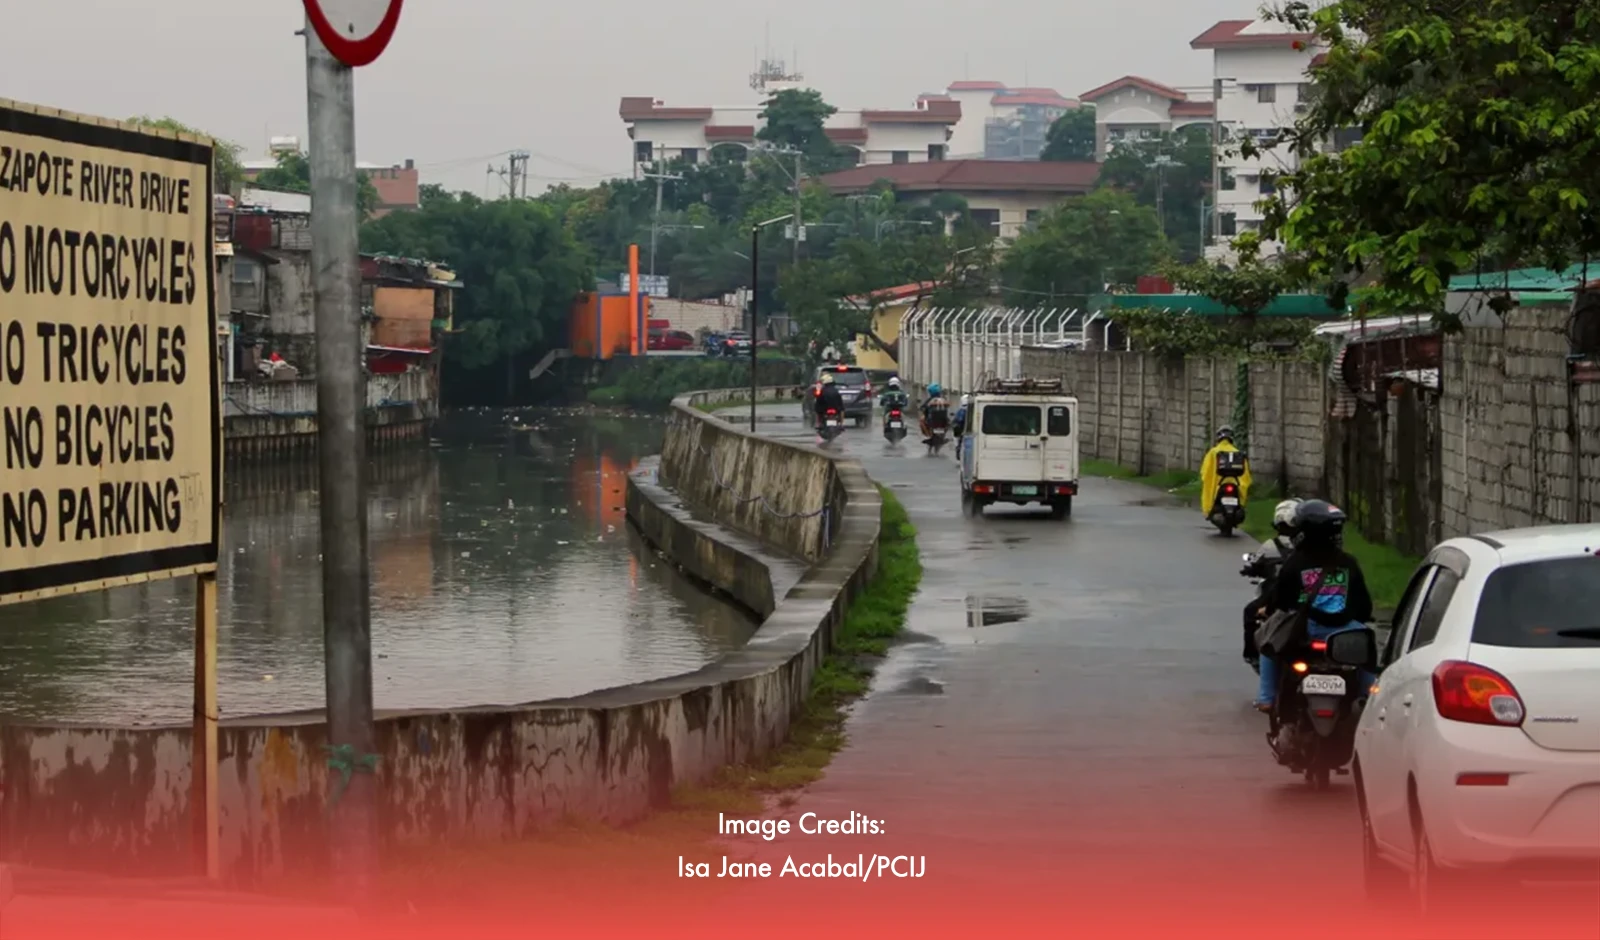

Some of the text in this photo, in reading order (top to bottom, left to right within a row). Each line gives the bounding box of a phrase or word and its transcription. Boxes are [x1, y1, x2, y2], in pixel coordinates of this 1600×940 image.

[0, 146, 190, 215] ZAPOTE RIVER DRIVE
[0, 220, 196, 305] O MOTORCYCLES
[0, 319, 186, 386] O TRICYCLES
[3, 401, 175, 470] NO BICYCLES
[2, 477, 182, 549] NO PARKING
